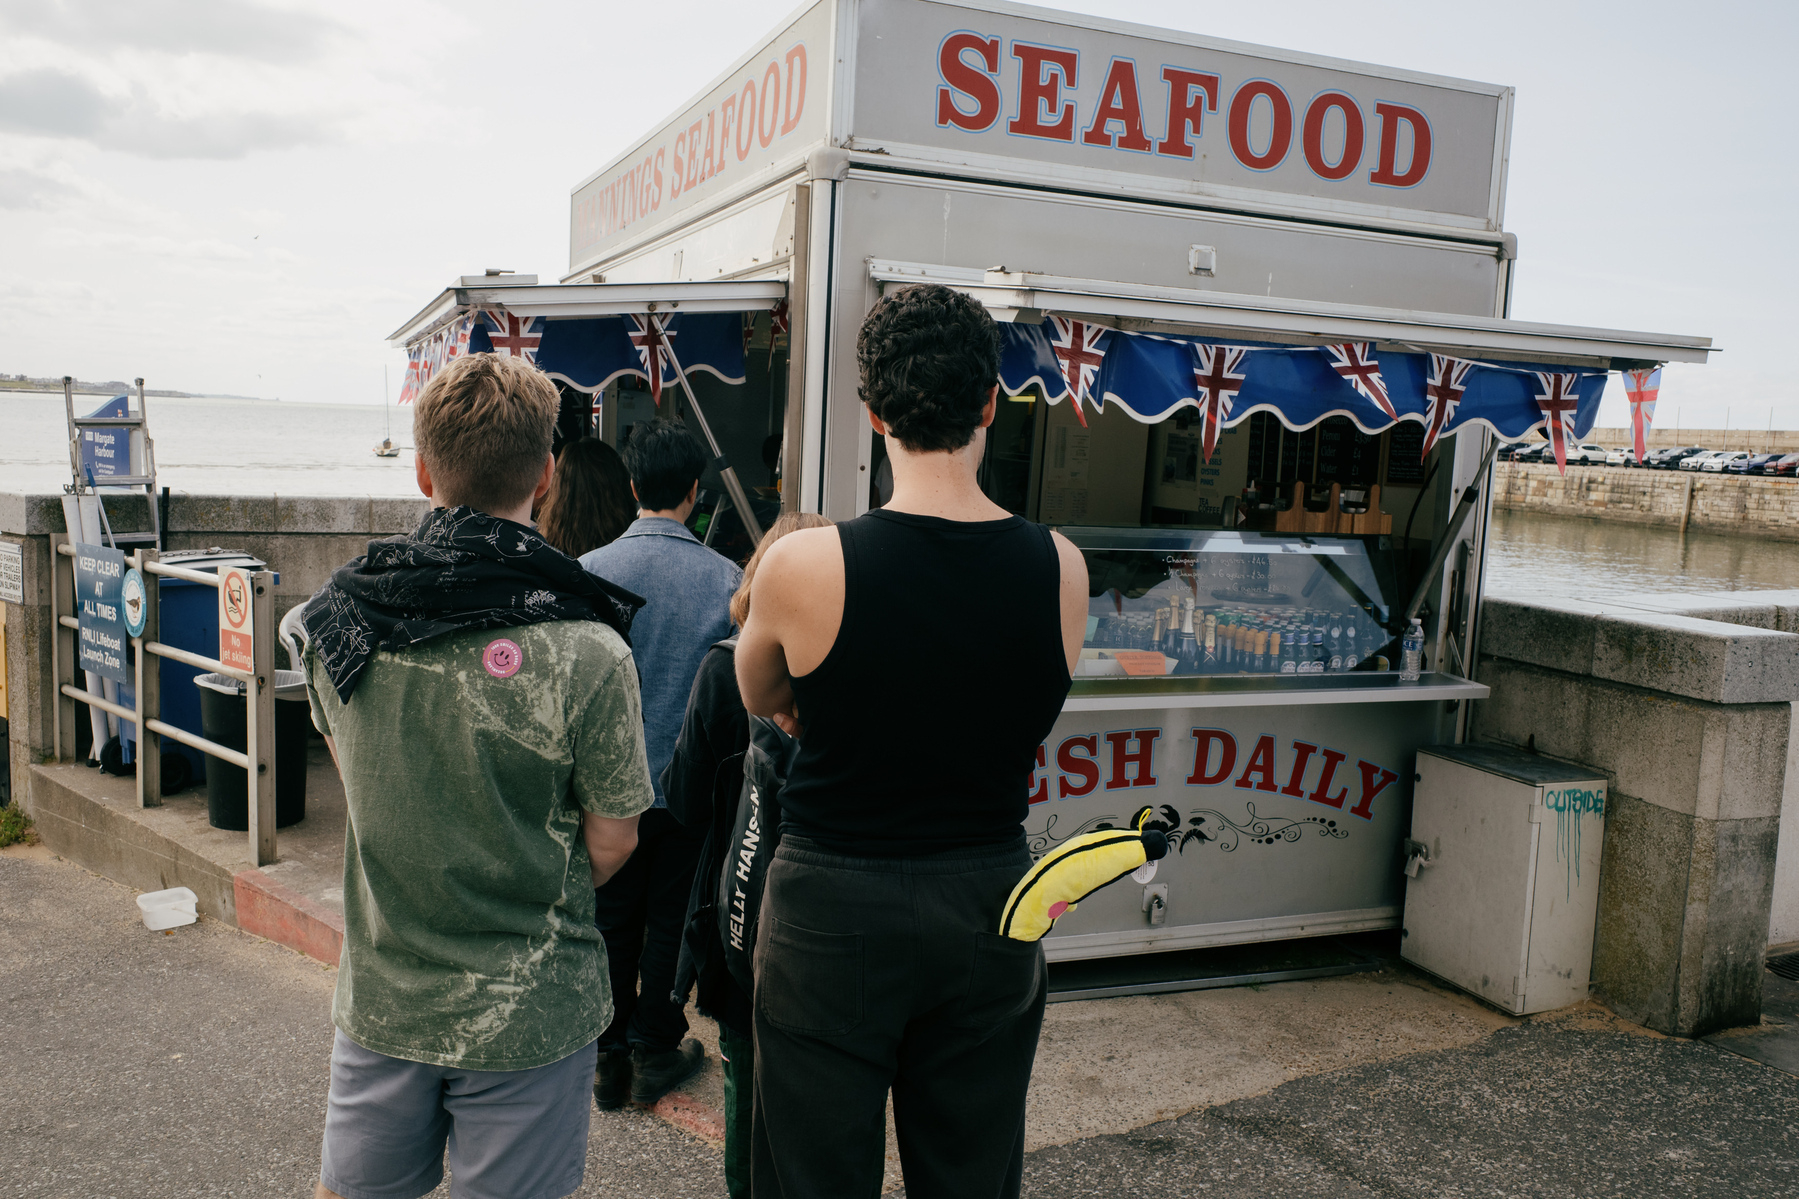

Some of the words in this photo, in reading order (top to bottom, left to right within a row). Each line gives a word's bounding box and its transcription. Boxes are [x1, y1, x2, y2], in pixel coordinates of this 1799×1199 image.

[937, 31, 1433, 188] SEAFOOD
[577, 146, 666, 252] MANNINGS
[670, 43, 808, 202] SEAFOOD
[94, 431, 115, 446] Margate
[94, 445, 115, 458] Harbour
[1201, 468, 1220, 476] OYSTERS
[1198, 505, 1220, 514] COFFEE
[1199, 498, 1209, 506] TEA
[3, 563, 21, 574] VEHICLES
[79, 556, 96, 572] KEEP
[96, 559, 120, 578] CLEAR
[4, 572, 21, 583] TRAILERS
[5, 581, 20, 591] SLIPWAY
[94, 581, 104, 597] AT
[83, 600, 96, 617] ALL
[96, 603, 117, 622] TIMES
[81, 627, 96, 644] RNLI
[96, 632, 121, 652] Lifeboat
[231, 634, 241, 647] No
[82, 645, 104, 664] Launch
[104, 652, 120, 668] Zone
[222, 648, 231, 661] jet
[231, 651, 251, 669] skiing
[1028, 727, 1162, 807] ESH
[1185, 727, 1400, 821] DAILY
[1545, 788, 1604, 815] OUTSIDE
[729, 881, 747, 952] HELLY
